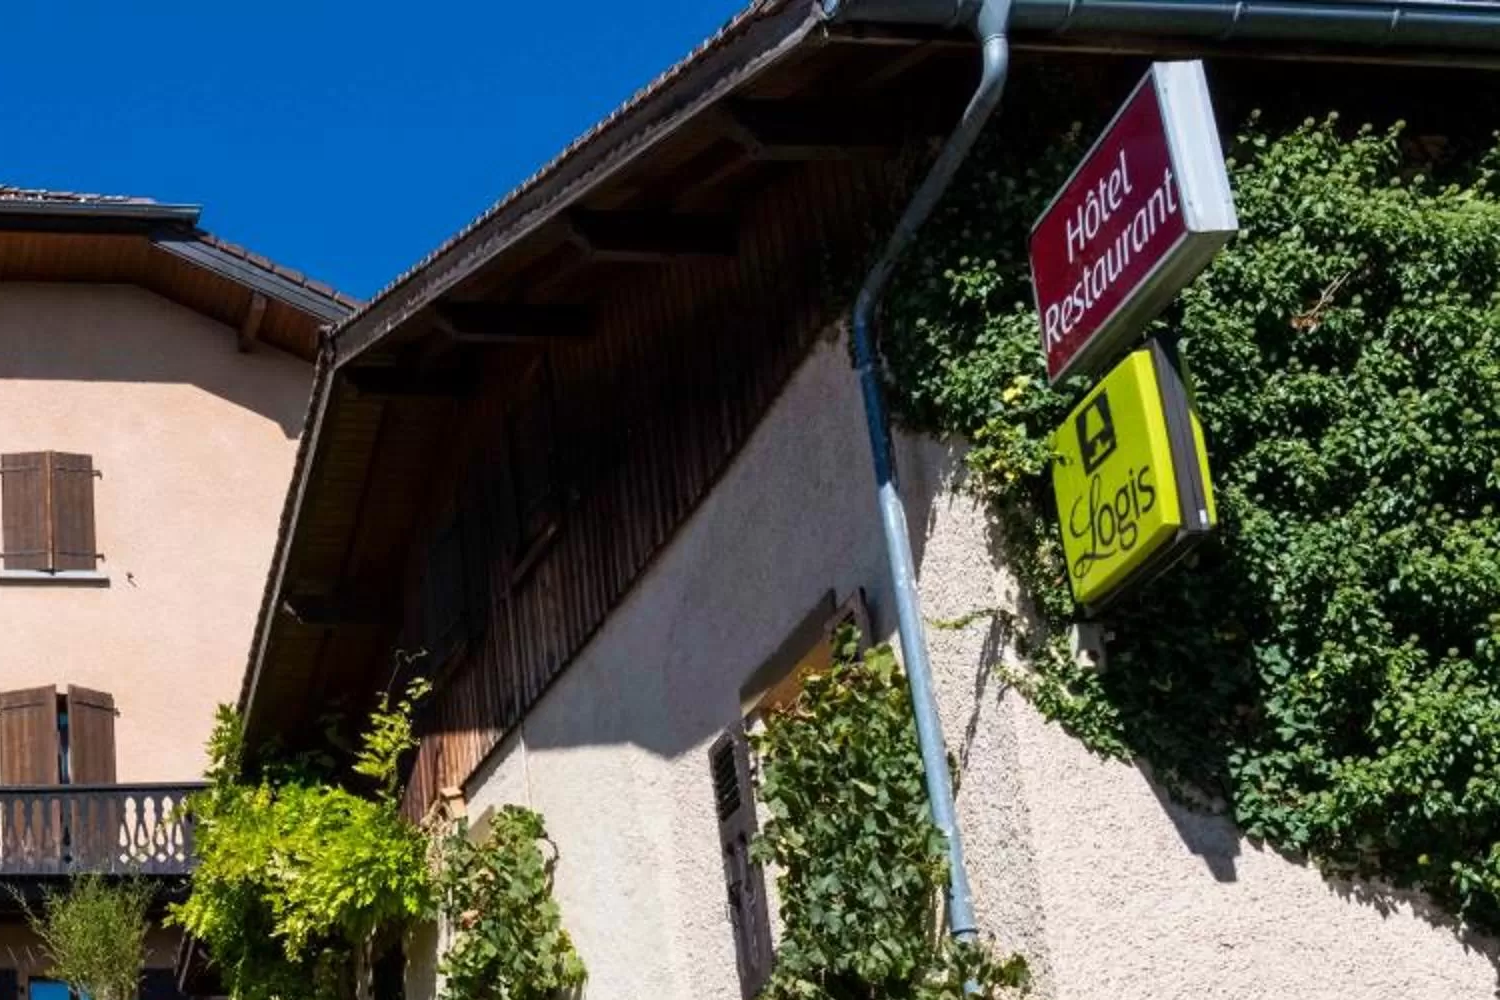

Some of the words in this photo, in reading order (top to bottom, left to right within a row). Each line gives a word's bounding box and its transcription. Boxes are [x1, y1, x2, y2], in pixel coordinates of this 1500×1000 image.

[1044, 168, 1177, 352] Restaurant
[1065, 150, 1132, 264] Hôtel
[1069, 464, 1157, 580] Logis
